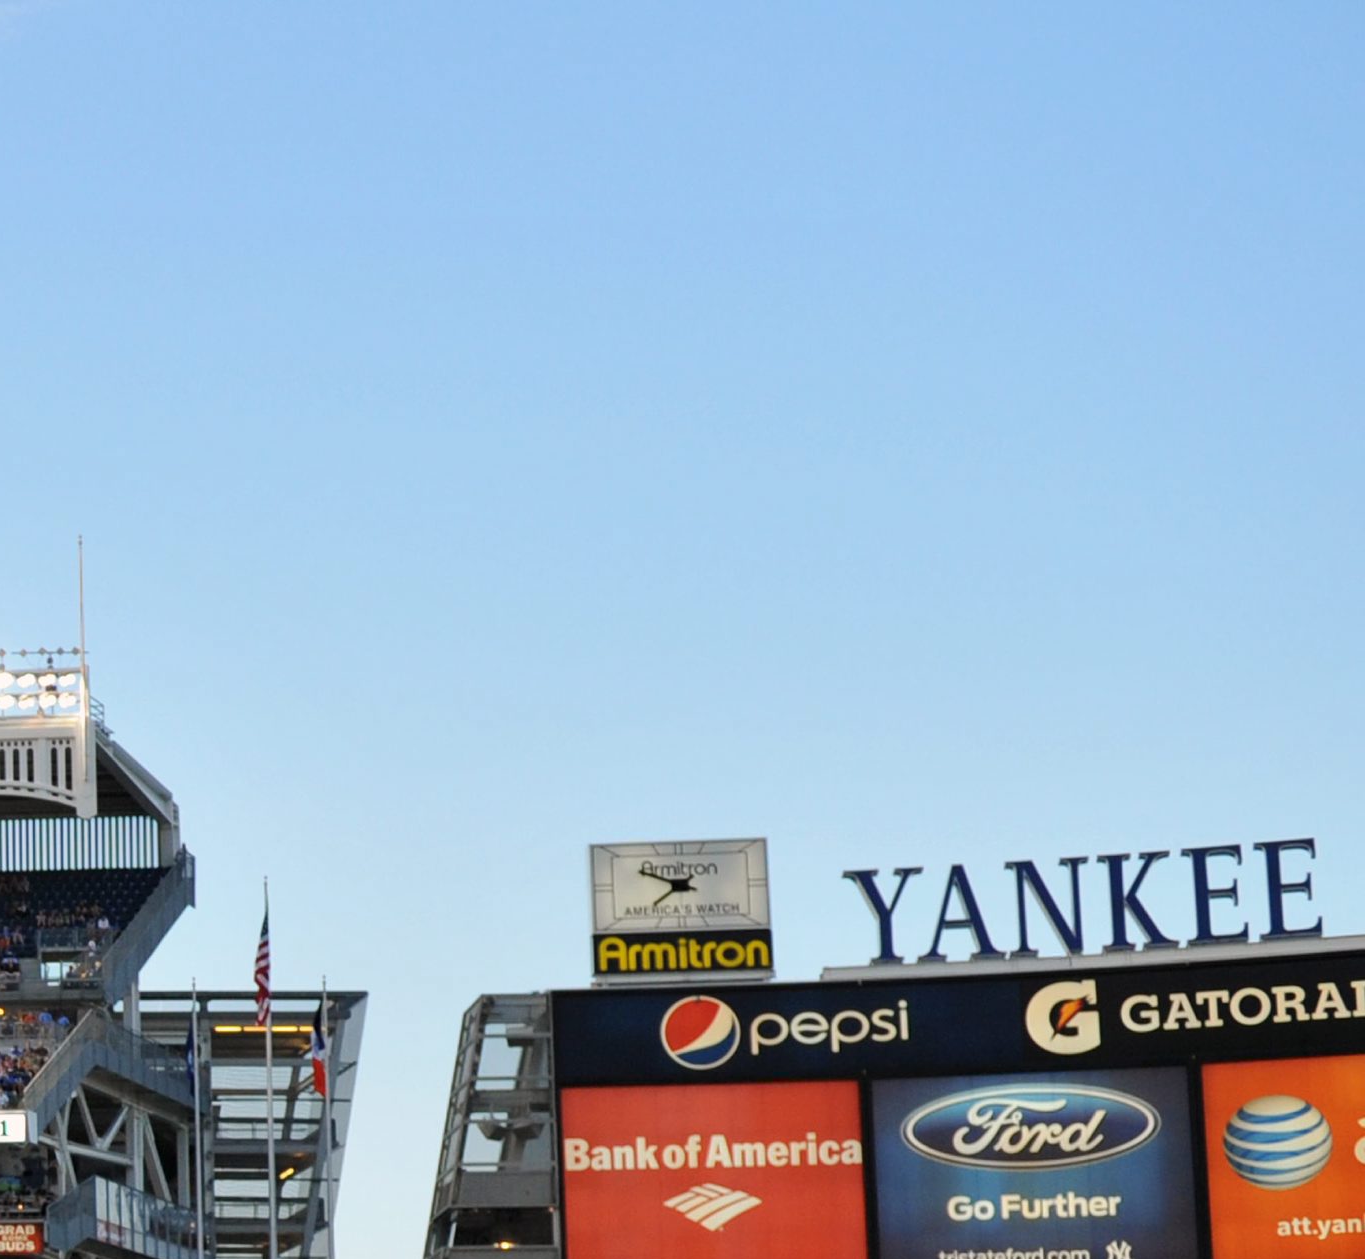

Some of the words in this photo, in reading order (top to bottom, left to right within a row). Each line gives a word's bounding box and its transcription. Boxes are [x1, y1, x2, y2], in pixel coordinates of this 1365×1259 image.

[641, 860, 718, 877] Armitron
[624, 904, 693, 916] AMERICA'S
[695, 903, 740, 914] WATCH
[841, 837, 1323, 965] YANKEE
[598, 936, 770, 972] Armitron
[1120, 979, 1365, 1033] GATORA
[750, 999, 909, 1056] pepsi
[0, 1120, 10, 1137] 1
[952, 1098, 1107, 1156] Ford
[564, 1136, 659, 1171] Bank
[662, 1134, 702, 1169] of
[705, 1132, 863, 1169] America
[947, 1195, 995, 1221] Go
[1000, 1191, 1122, 1220] Further
[1277, 1214, 1365, 1240] att.yan
